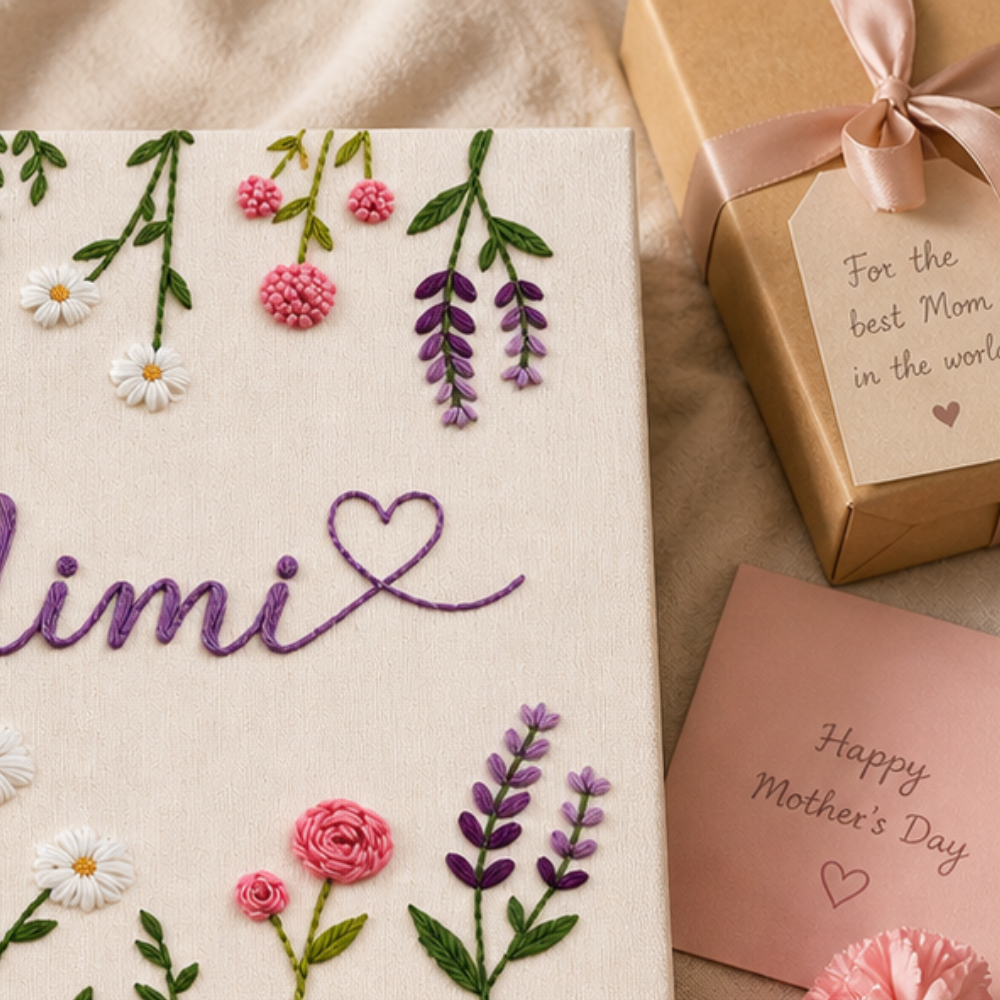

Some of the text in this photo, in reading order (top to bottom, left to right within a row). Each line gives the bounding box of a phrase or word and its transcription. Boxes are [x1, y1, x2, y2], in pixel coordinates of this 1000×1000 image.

[843, 239, 958, 288] For the
[850, 291, 993, 338] best Mom
[853, 332, 1000, 388] in the worl
[814, 723, 931, 797] Happy
[751, 771, 970, 877] Mother's Day
